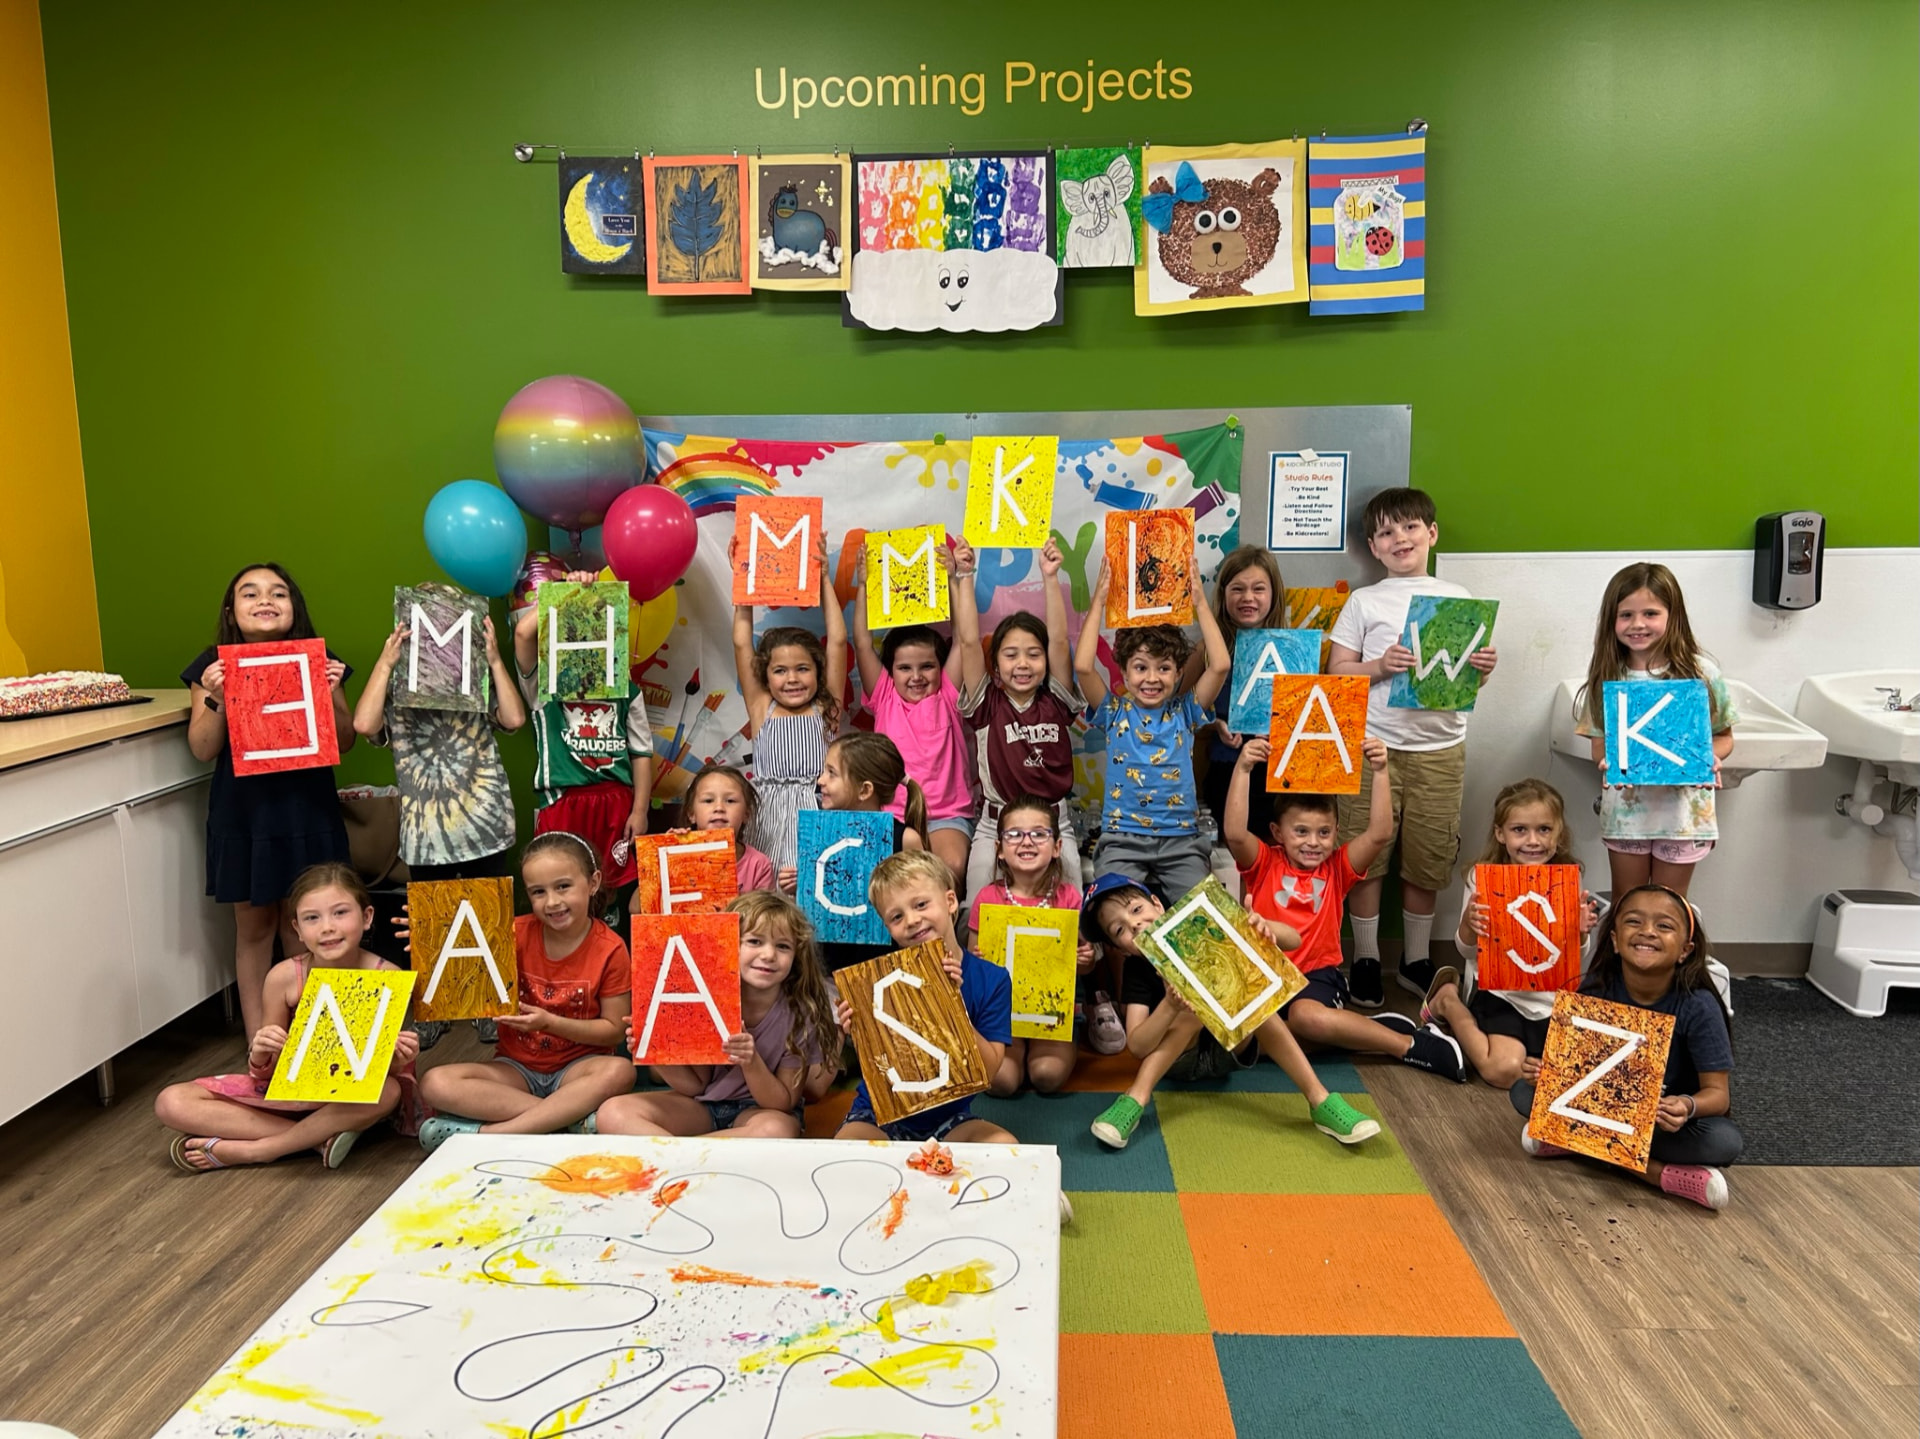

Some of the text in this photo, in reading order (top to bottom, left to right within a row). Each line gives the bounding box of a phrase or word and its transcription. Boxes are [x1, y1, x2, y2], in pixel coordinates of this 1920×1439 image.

[755, 59, 1193, 119] Upcoming Projects
[990, 446, 1035, 532] K
[747, 511, 810, 595] M
[882, 533, 937, 616] M
[1128, 520, 1172, 619] L
[408, 603, 474, 696] M
[548, 604, 615, 695] H
[1237, 641, 1287, 705] A
[1410, 621, 1485, 682] W
[561, 731, 627, 752] MRAUDERS
[1273, 685, 1354, 779] A
[1617, 690, 1686, 770] K
[814, 837, 867, 916] C
[422, 900, 511, 1004] A
[1507, 890, 1561, 974] S
[287, 983, 392, 1083] N
[635, 934, 730, 1060] A
[873, 968, 950, 1093] S
[1549, 1015, 1647, 1135] Z
